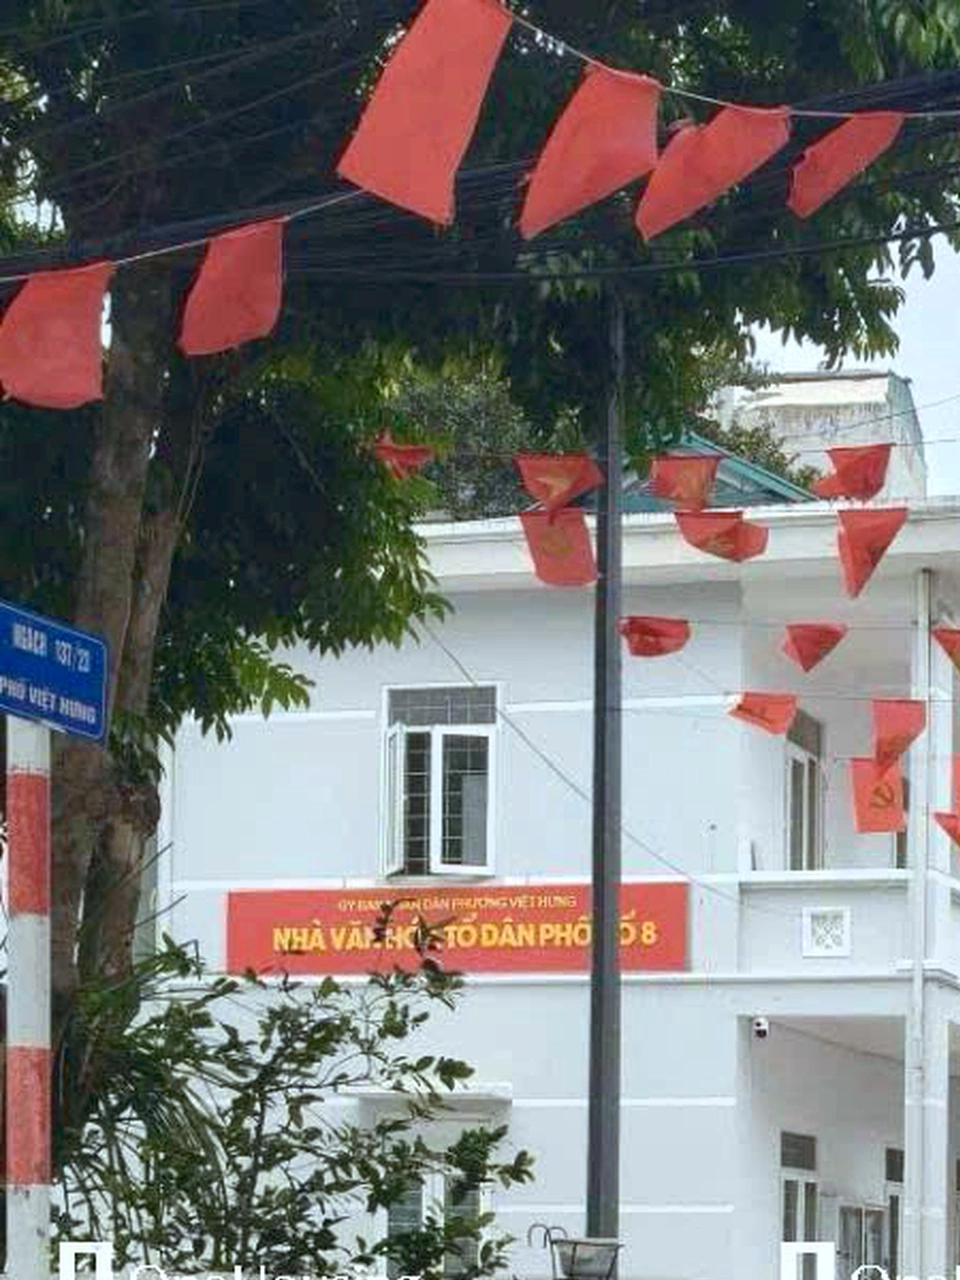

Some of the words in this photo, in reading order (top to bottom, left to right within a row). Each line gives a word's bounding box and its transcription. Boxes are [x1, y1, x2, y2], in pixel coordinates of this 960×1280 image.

[273, 918, 327, 951] NHÀ
[480, 916, 535, 948] DÂN
[641, 920, 658, 946] 8
